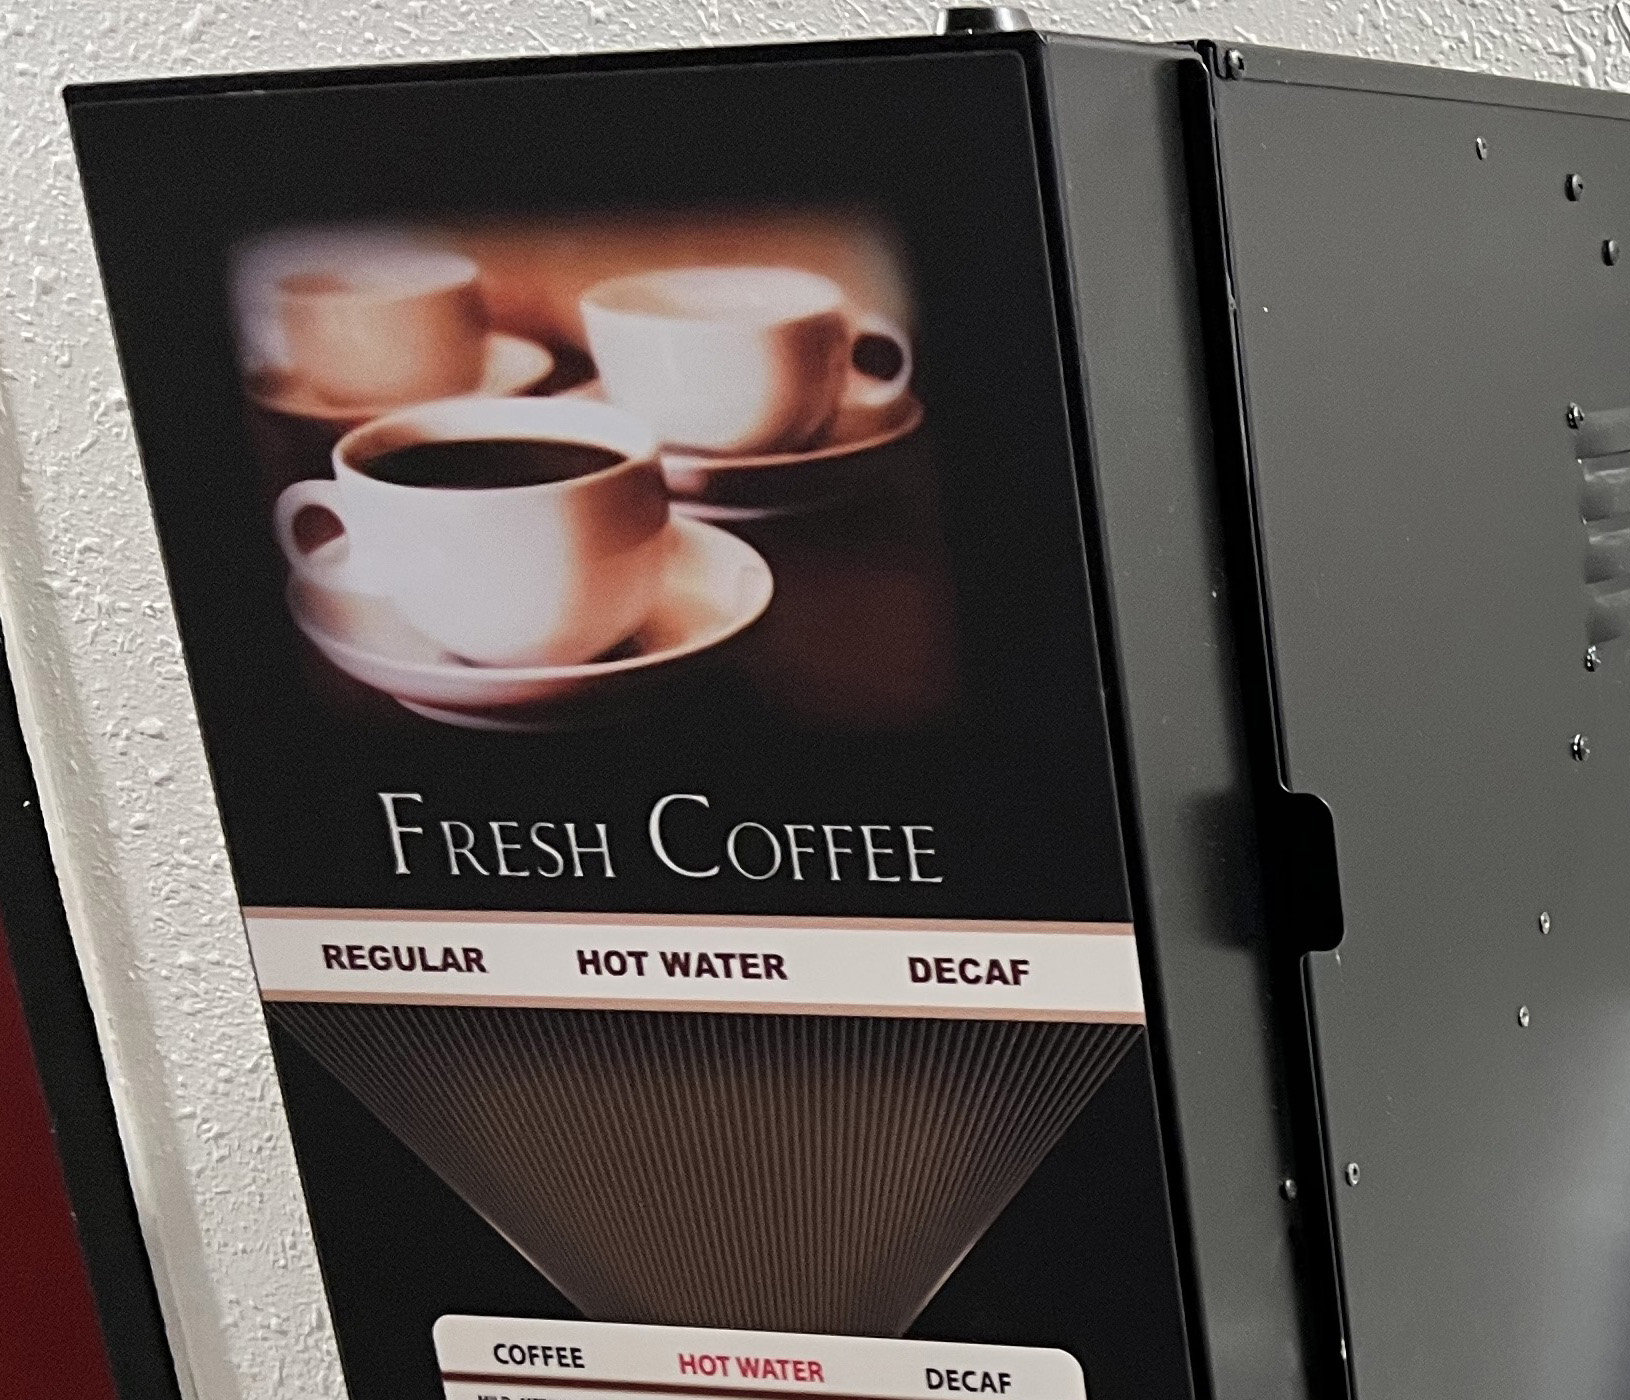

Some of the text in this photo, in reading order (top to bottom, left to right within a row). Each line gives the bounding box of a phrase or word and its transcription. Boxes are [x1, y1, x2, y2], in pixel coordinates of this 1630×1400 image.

[321, 943, 489, 974] REGULAR
[576, 949, 789, 980] HOT WATER
[908, 956, 1030, 986] DECAF
[493, 1343, 585, 1368] COFFEE
[678, 1353, 825, 1383] HOT WATER
[925, 1367, 1012, 1394] DECAF
